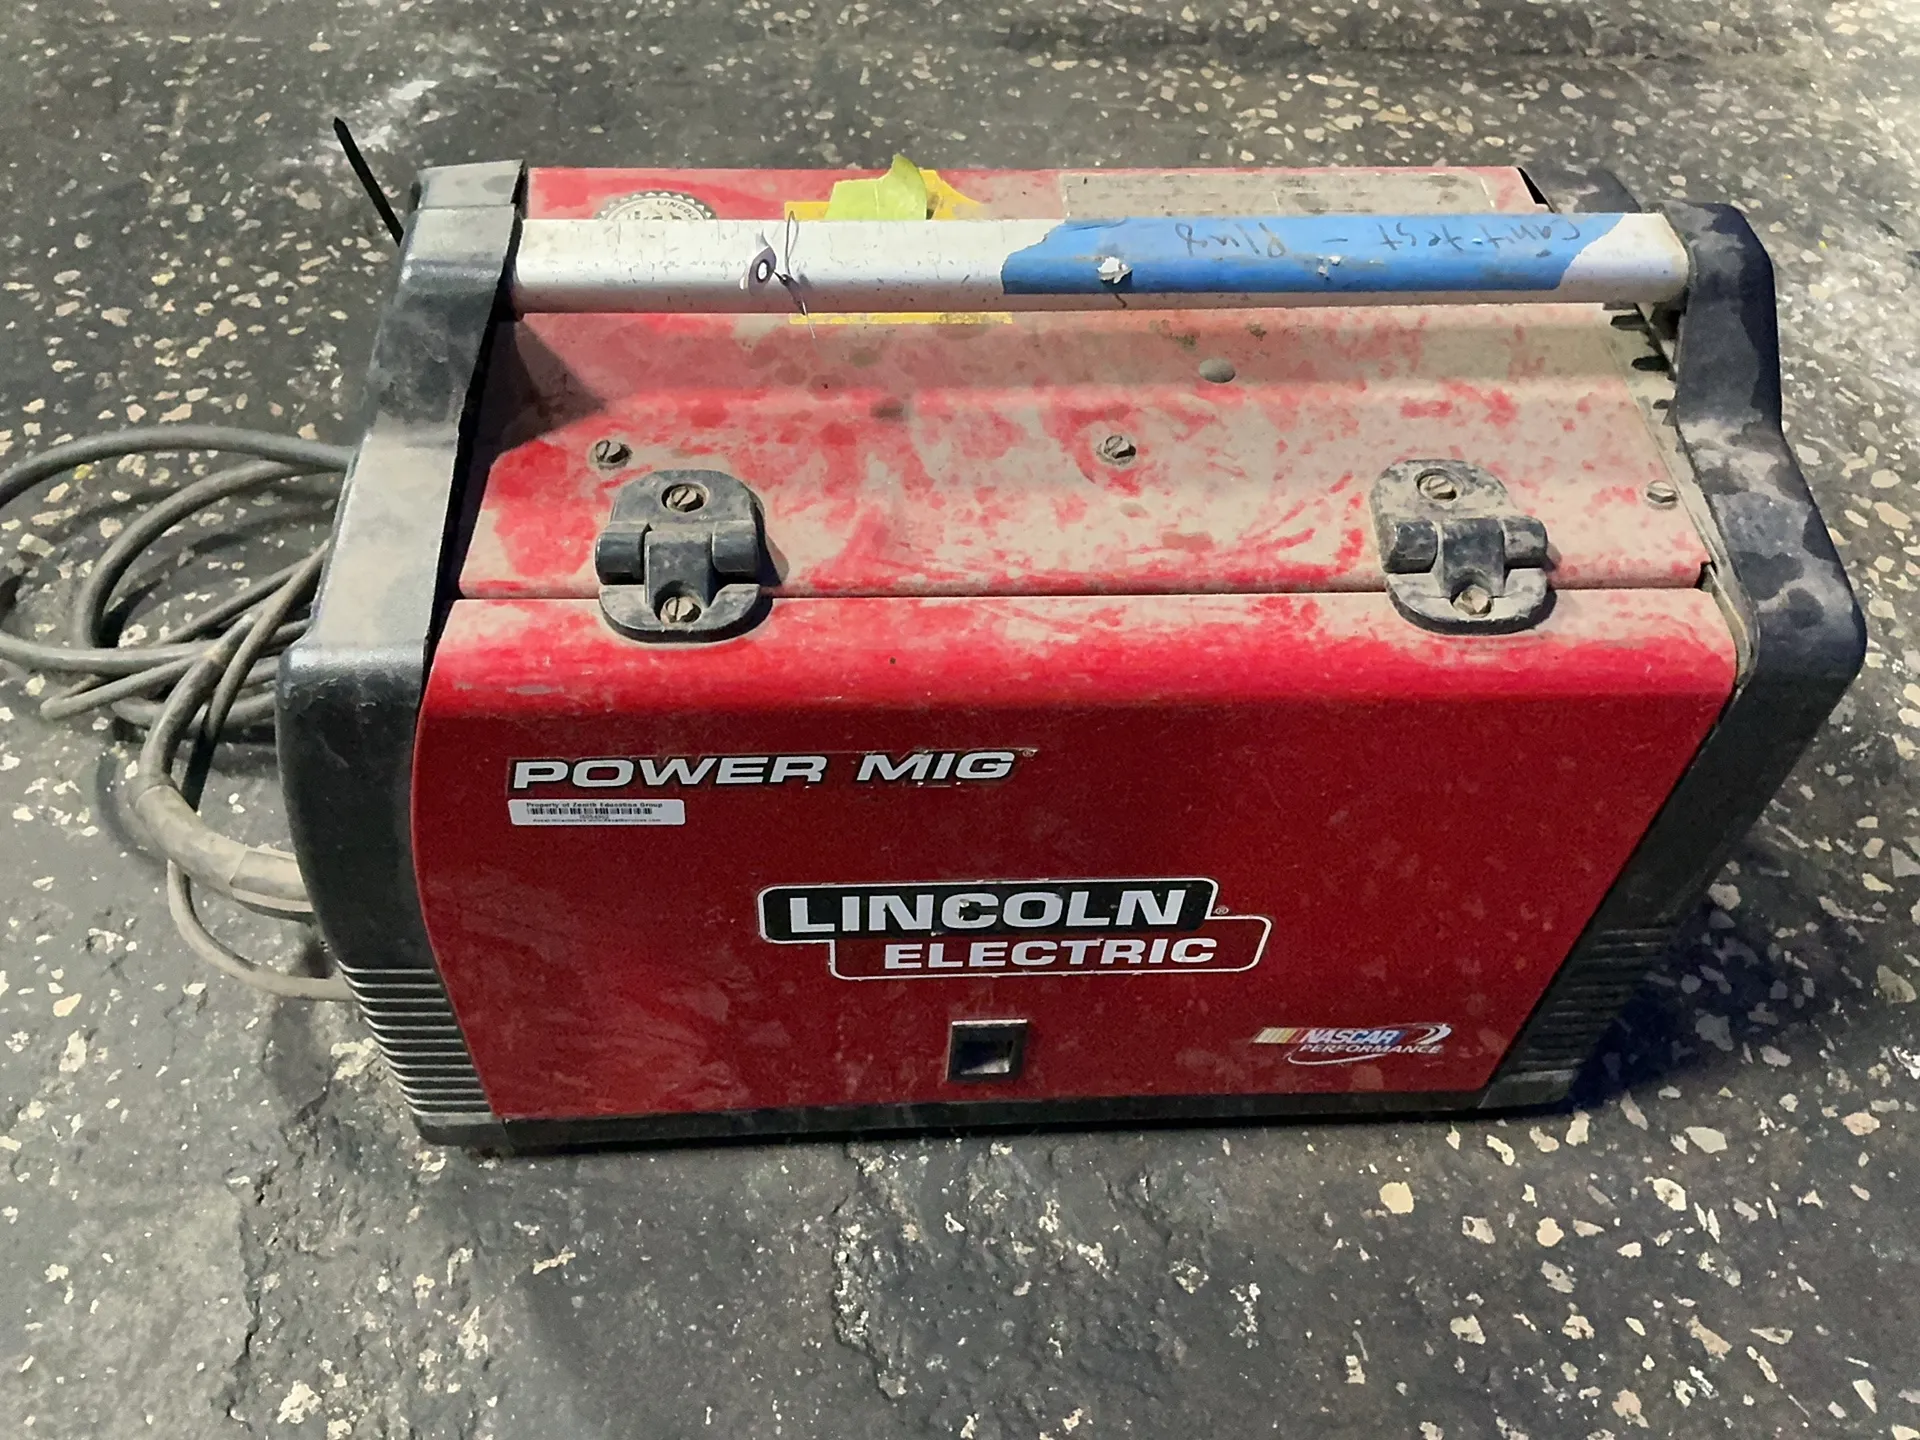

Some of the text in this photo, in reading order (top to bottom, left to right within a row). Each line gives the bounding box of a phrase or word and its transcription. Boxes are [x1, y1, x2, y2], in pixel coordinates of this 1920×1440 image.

[1376, 222, 1463, 254] test
[513, 752, 1015, 789] POWER MIG
[790, 889, 1187, 934] LINCOLN
[886, 938, 1217, 970] ELECTRIC
[1299, 1028, 1396, 1044] NASCAR
[1299, 1043, 1441, 1055] PERFORMANCE
